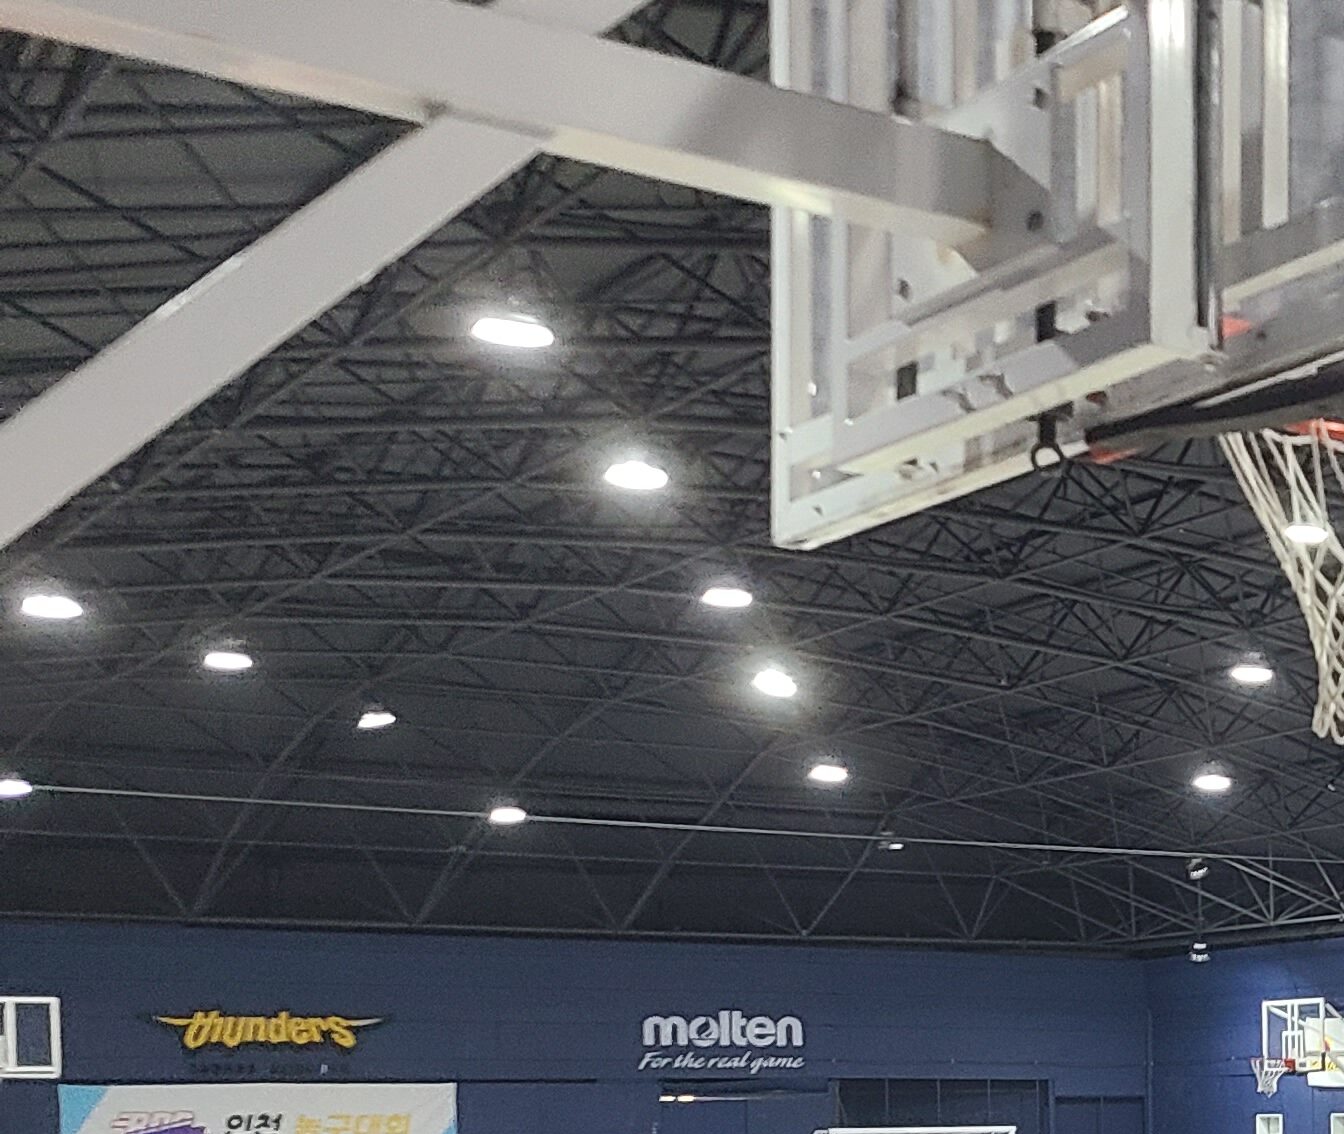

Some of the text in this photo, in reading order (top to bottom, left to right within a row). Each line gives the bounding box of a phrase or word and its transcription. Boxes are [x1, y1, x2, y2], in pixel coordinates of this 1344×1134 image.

[642, 1010, 804, 1047] molten
[638, 1051, 806, 1074] For the real game
